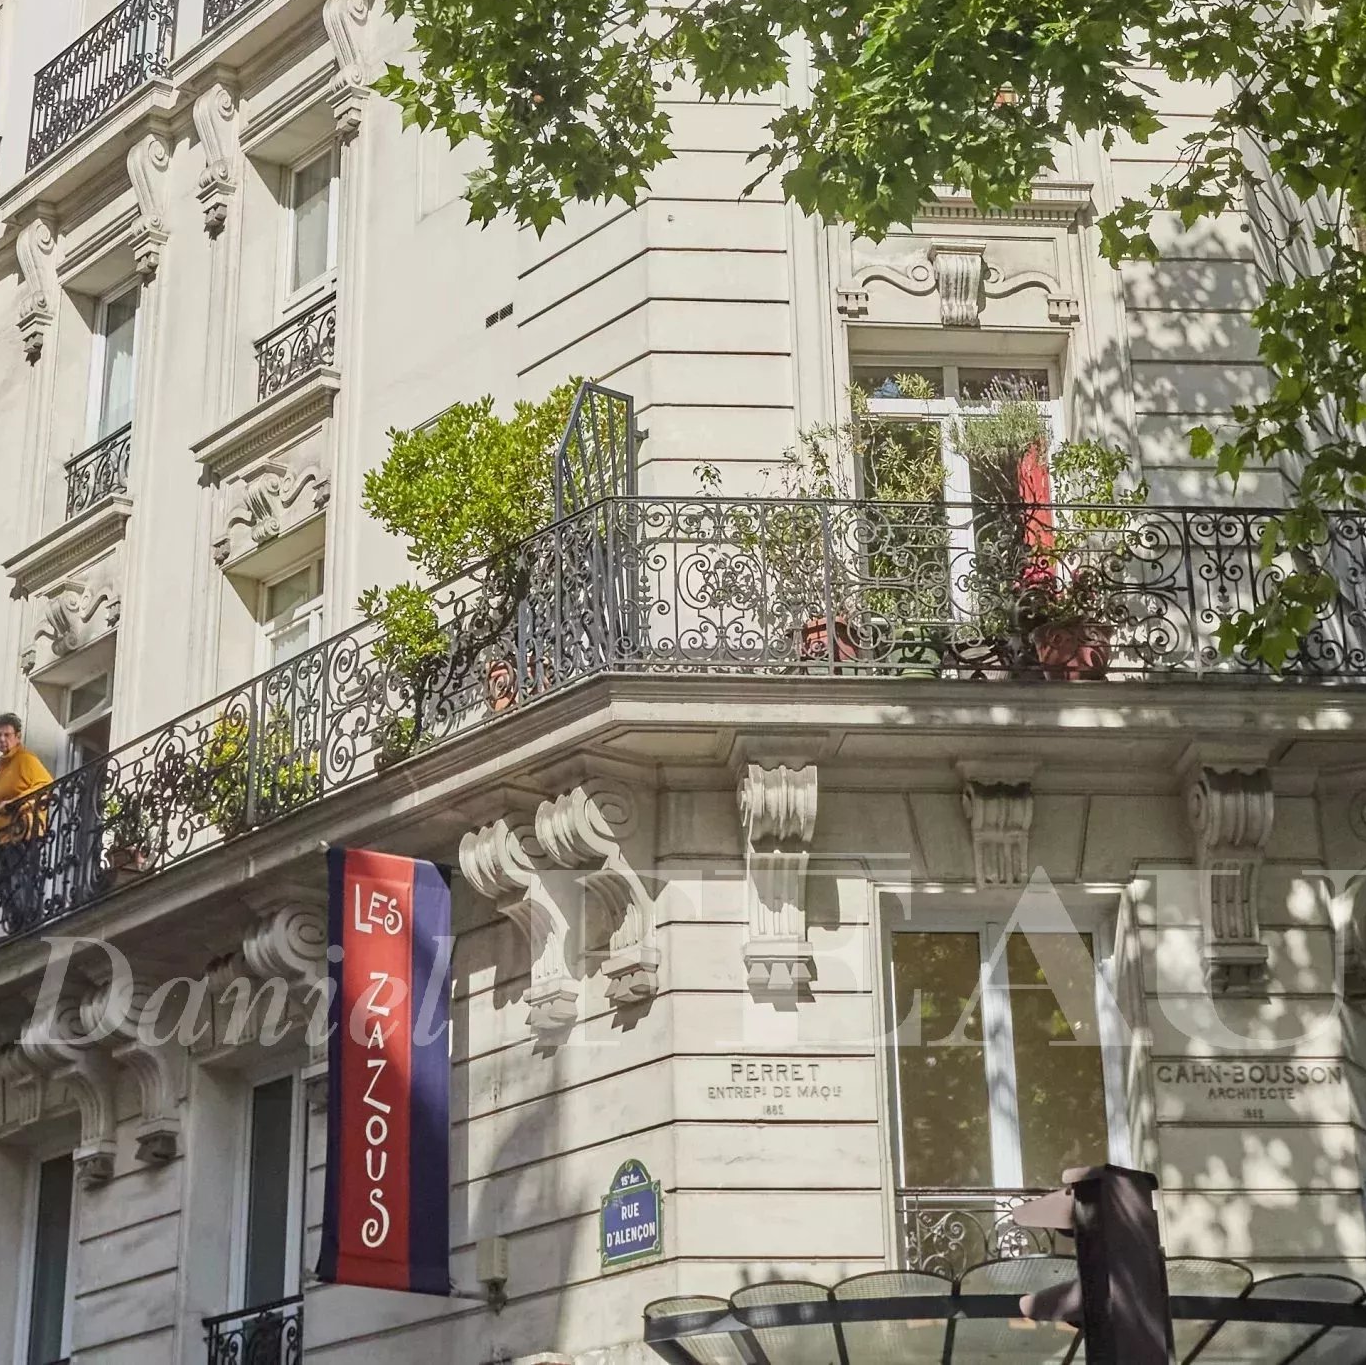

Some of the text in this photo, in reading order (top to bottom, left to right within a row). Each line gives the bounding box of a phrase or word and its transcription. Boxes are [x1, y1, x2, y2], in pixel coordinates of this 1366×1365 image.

[354, 883, 403, 935] LES
[731, 1063, 819, 1082] PERRET
[773, 1086, 792, 1099] DE
[1207, 1087, 1296, 1100] ARCHITECTE
[361, 971, 392, 1249] ZAZOUS
[621, 1202, 640, 1221] RUE
[606, 1221, 656, 1248] D'ALENÇON
